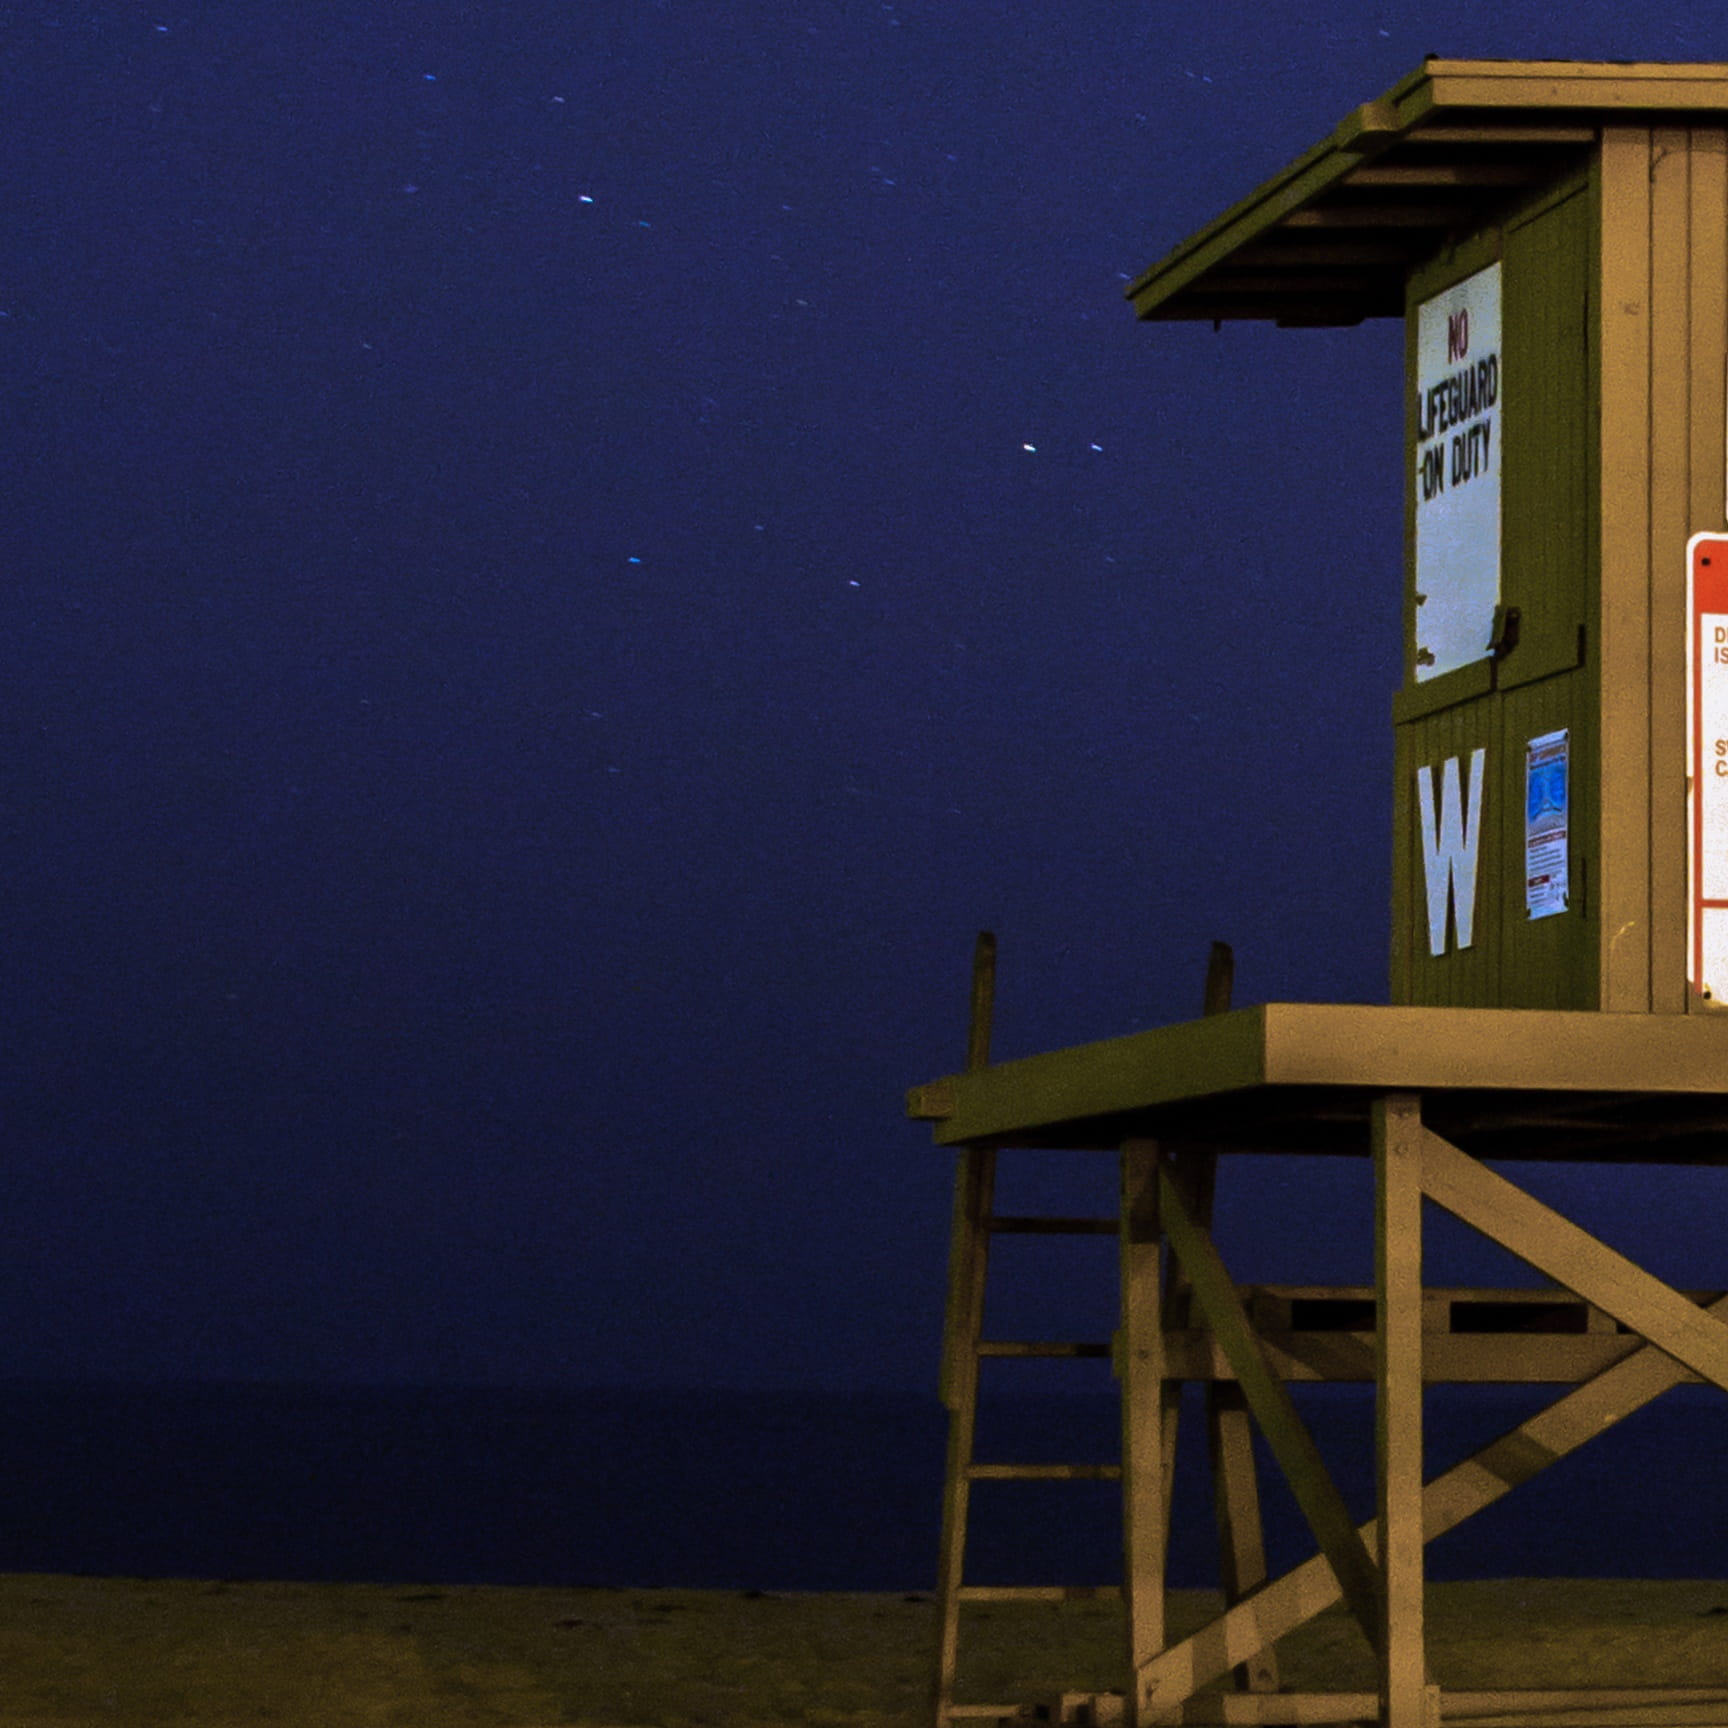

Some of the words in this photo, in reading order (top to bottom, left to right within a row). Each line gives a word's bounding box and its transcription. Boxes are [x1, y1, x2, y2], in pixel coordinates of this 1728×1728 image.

[1448, 308, 1469, 365] NO
[1417, 354, 1498, 441] LIFEGUARD
[1422, 442, 1444, 501] ON
[1452, 419, 1491, 486] DUTY
[1418, 748, 1485, 957] W
